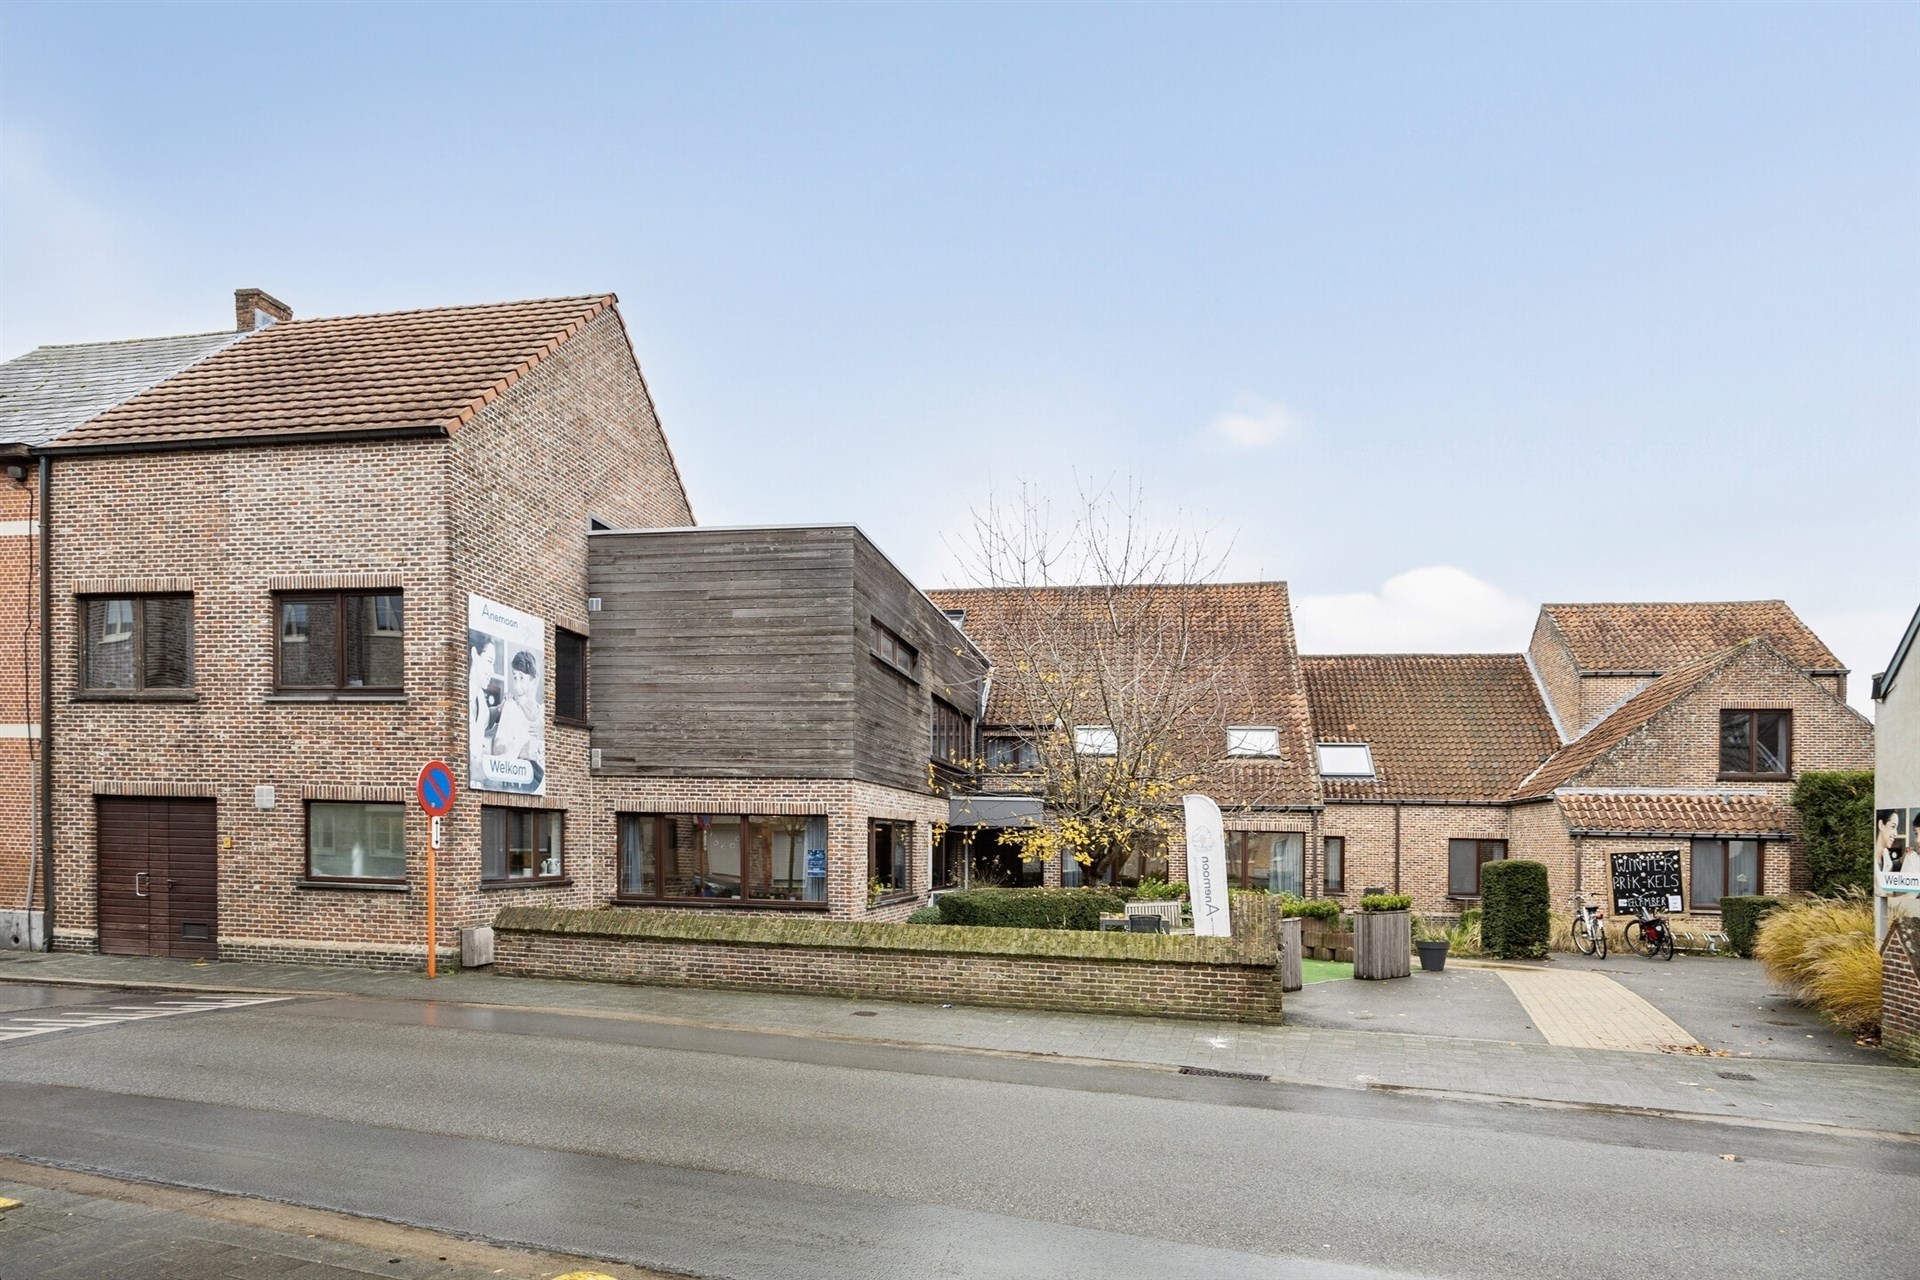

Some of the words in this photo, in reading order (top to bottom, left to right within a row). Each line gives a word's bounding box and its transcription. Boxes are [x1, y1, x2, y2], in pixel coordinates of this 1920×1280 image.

[482, 603, 519, 629] Anemoon
[490, 759, 527, 776] Welkom
[1615, 857, 1675, 872] WINTER
[1884, 874, 1919, 886] Welkom
